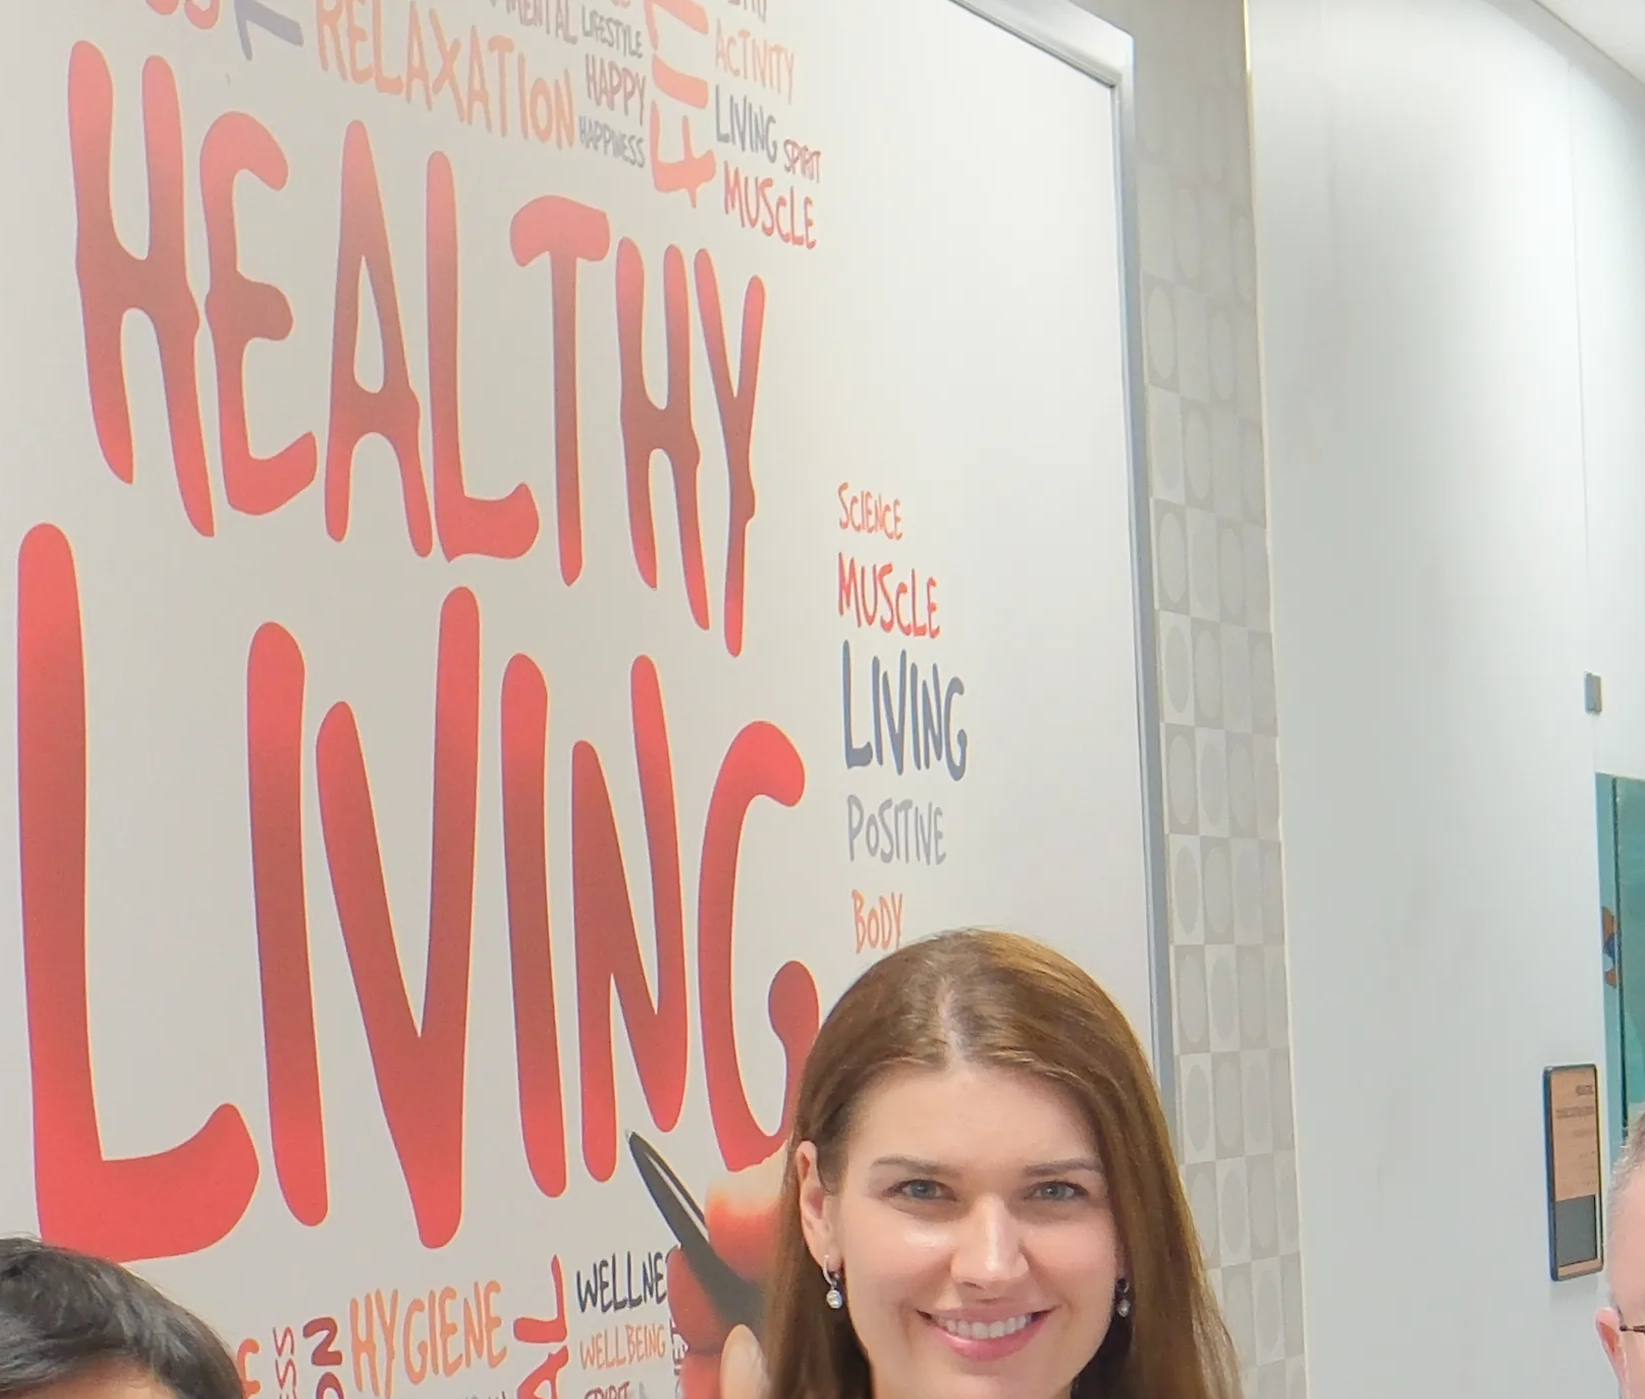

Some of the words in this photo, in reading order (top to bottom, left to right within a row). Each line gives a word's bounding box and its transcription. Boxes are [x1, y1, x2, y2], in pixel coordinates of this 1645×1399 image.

[581, 5, 643, 58] LIFESTYLE
[716, 19, 794, 104] ACTIVITY
[316, 0, 575, 150] RELAXATION
[585, 53, 647, 127] HAPPY
[578, 114, 646, 168] HAPPINESS
[715, 84, 778, 163] LIVING
[783, 138, 822, 184] SPIRIT
[723, 160, 816, 250] MUSCLE
[66, 39, 766, 657] HEALTHY
[837, 481, 903, 540] SCIENCE
[837, 551, 940, 639] MUSCLE
[841, 639, 968, 781] LIVING
[846, 794, 947, 866] POSITIVE
[17, 522, 820, 1262] LIVING
[850, 889, 904, 955] BODY
[576, 1250, 669, 1313] WELLNE
